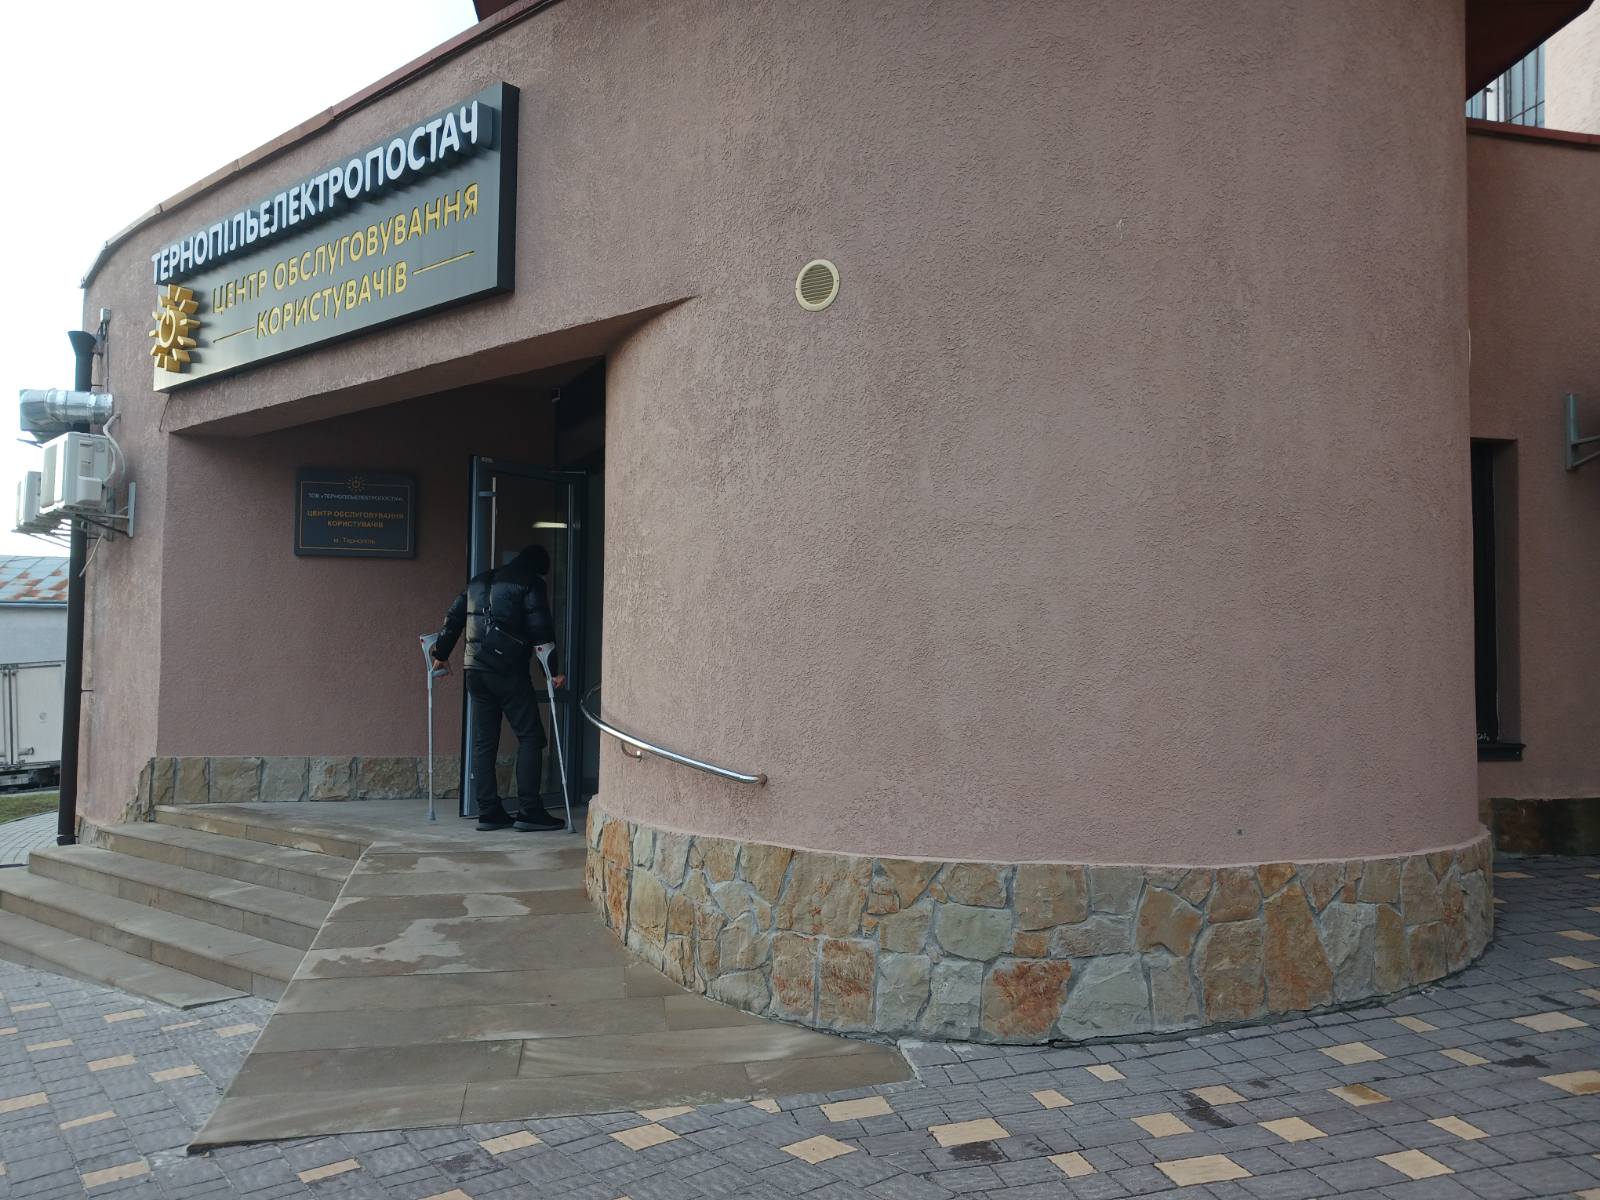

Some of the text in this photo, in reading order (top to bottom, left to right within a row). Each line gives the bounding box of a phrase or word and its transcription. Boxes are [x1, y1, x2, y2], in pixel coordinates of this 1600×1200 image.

[151, 100, 479, 285] ТЕРНОПІЛЬЕЛЕКТРОПОСТАЧ
[211, 182, 480, 315] ЦЕНТР ОБСЛУГОВУВАННЯ
[256, 260, 408, 339] КОРИСТУВАЧІВ
[306, 510, 333, 518] ЦЕНТР
